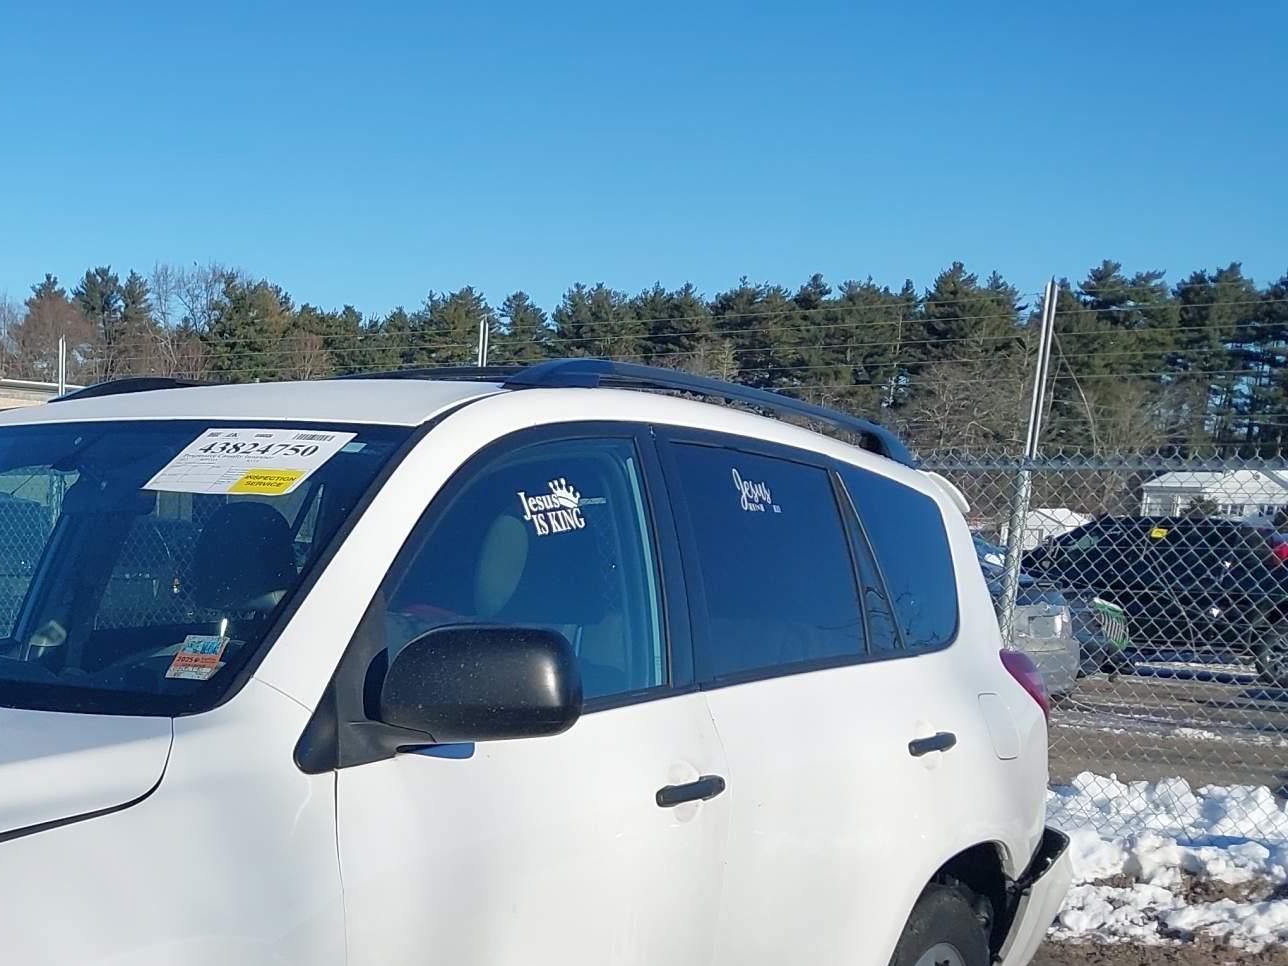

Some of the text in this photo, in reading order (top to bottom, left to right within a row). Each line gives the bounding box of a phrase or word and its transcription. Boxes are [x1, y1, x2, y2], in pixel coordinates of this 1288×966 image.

[199, 441, 320, 457] 43824750
[244, 480, 284, 488] SERVICE
[245, 474, 297, 482] INSPECTION
[732, 468, 772, 511] Jesus
[517, 491, 561, 521] Jesus
[531, 507, 586, 536] IS KING
